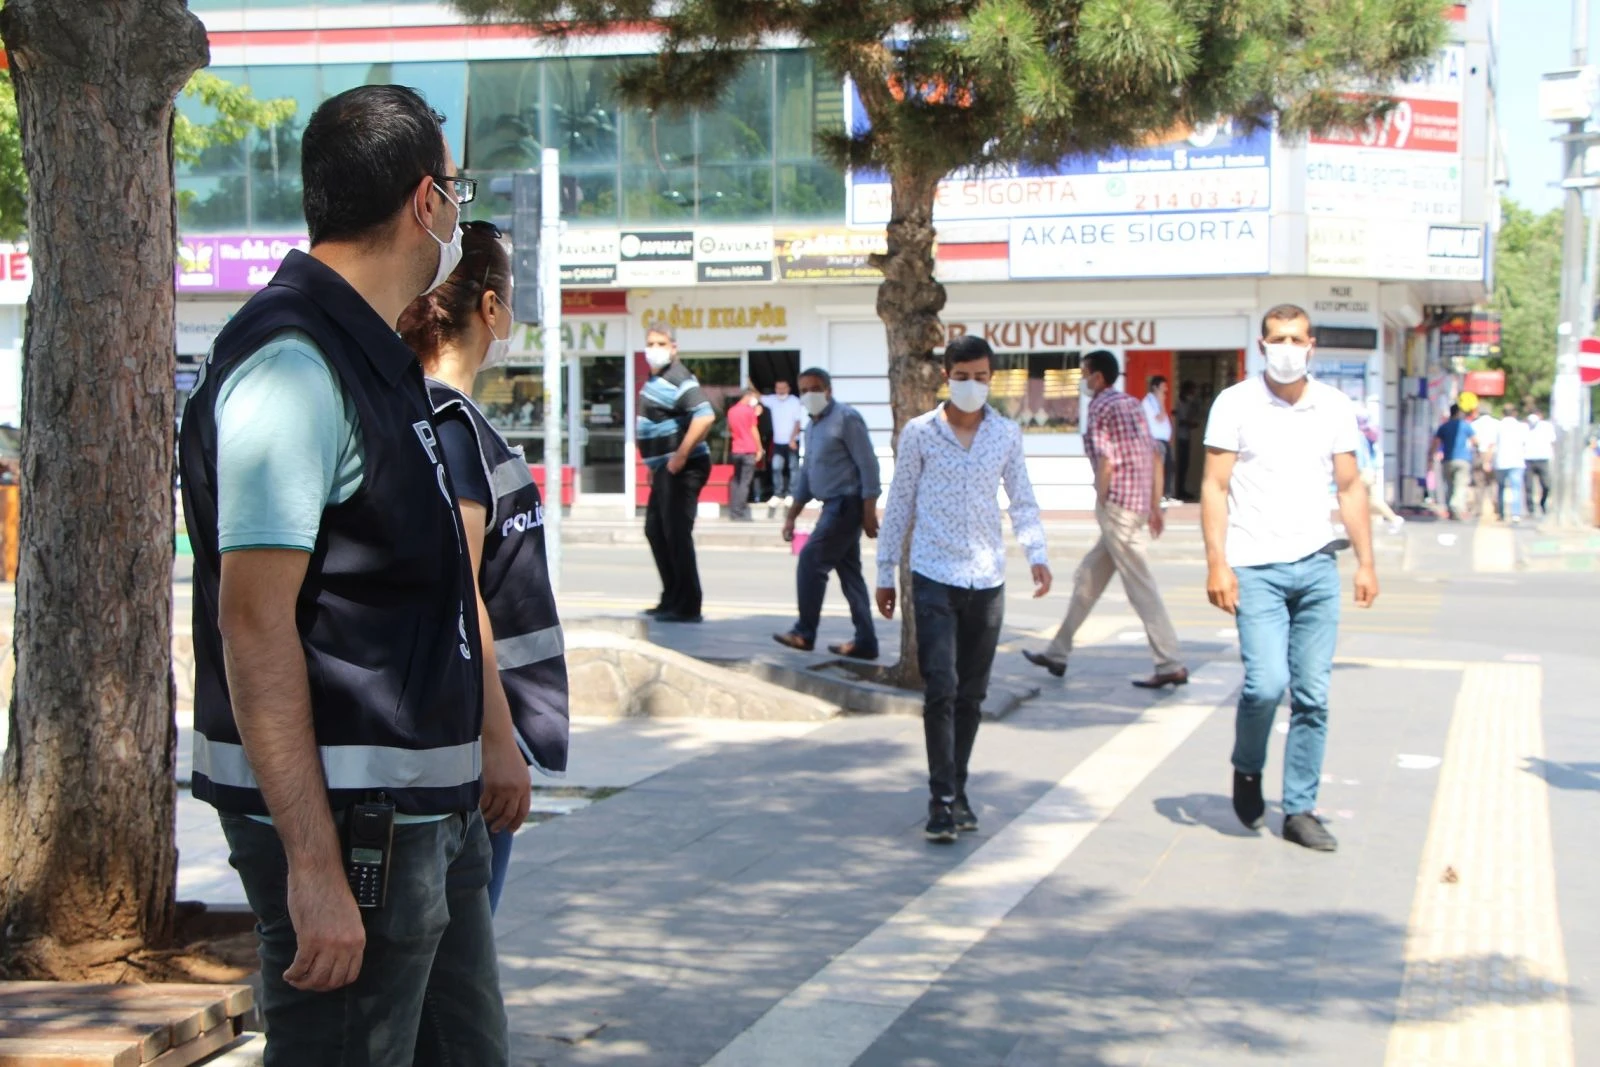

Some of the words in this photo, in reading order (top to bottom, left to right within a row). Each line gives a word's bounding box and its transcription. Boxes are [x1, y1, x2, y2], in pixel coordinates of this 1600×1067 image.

[1136, 194, 1179, 211] 214
[1021, 223, 1115, 246] AKABE
[565, 244, 614, 254] AVUKAT
[639, 240, 693, 255] AVUKAT
[718, 241, 768, 252] AVUKAT
[984, 320, 1156, 348] KUYUMCUSU
